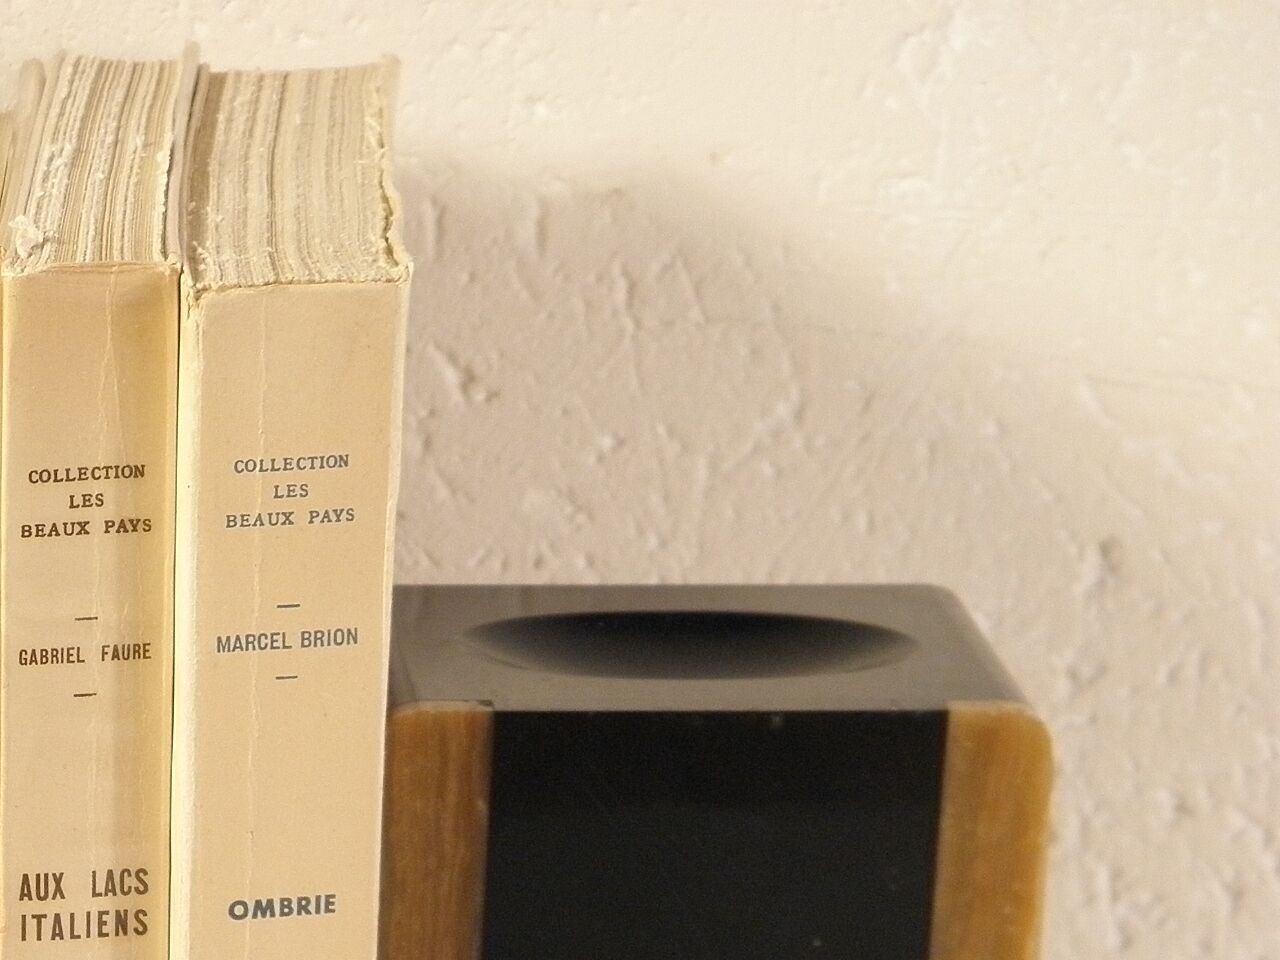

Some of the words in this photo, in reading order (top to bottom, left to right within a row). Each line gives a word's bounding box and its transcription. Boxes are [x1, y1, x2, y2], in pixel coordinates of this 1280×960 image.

[28, 464, 145, 484] COLLECTION
[234, 454, 349, 474] COLLECTION
[69, 493, 104, 509] LES
[273, 483, 309, 499] LES
[21, 521, 90, 538] BEAUX
[104, 518, 152, 534] PAYS
[226, 512, 295, 528] BEAUX
[308, 508, 355, 524] PAYS
[217, 632, 292, 653] MARCEL
[300, 627, 358, 648] BRION
[19, 646, 85, 666] GABRIEL
[101, 642, 152, 662] FAURE
[19, 872, 65, 901] AUX
[92, 868, 149, 898] LACS
[228, 894, 336, 920] OMBRIE
[21, 909, 148, 942] ITALIENS
